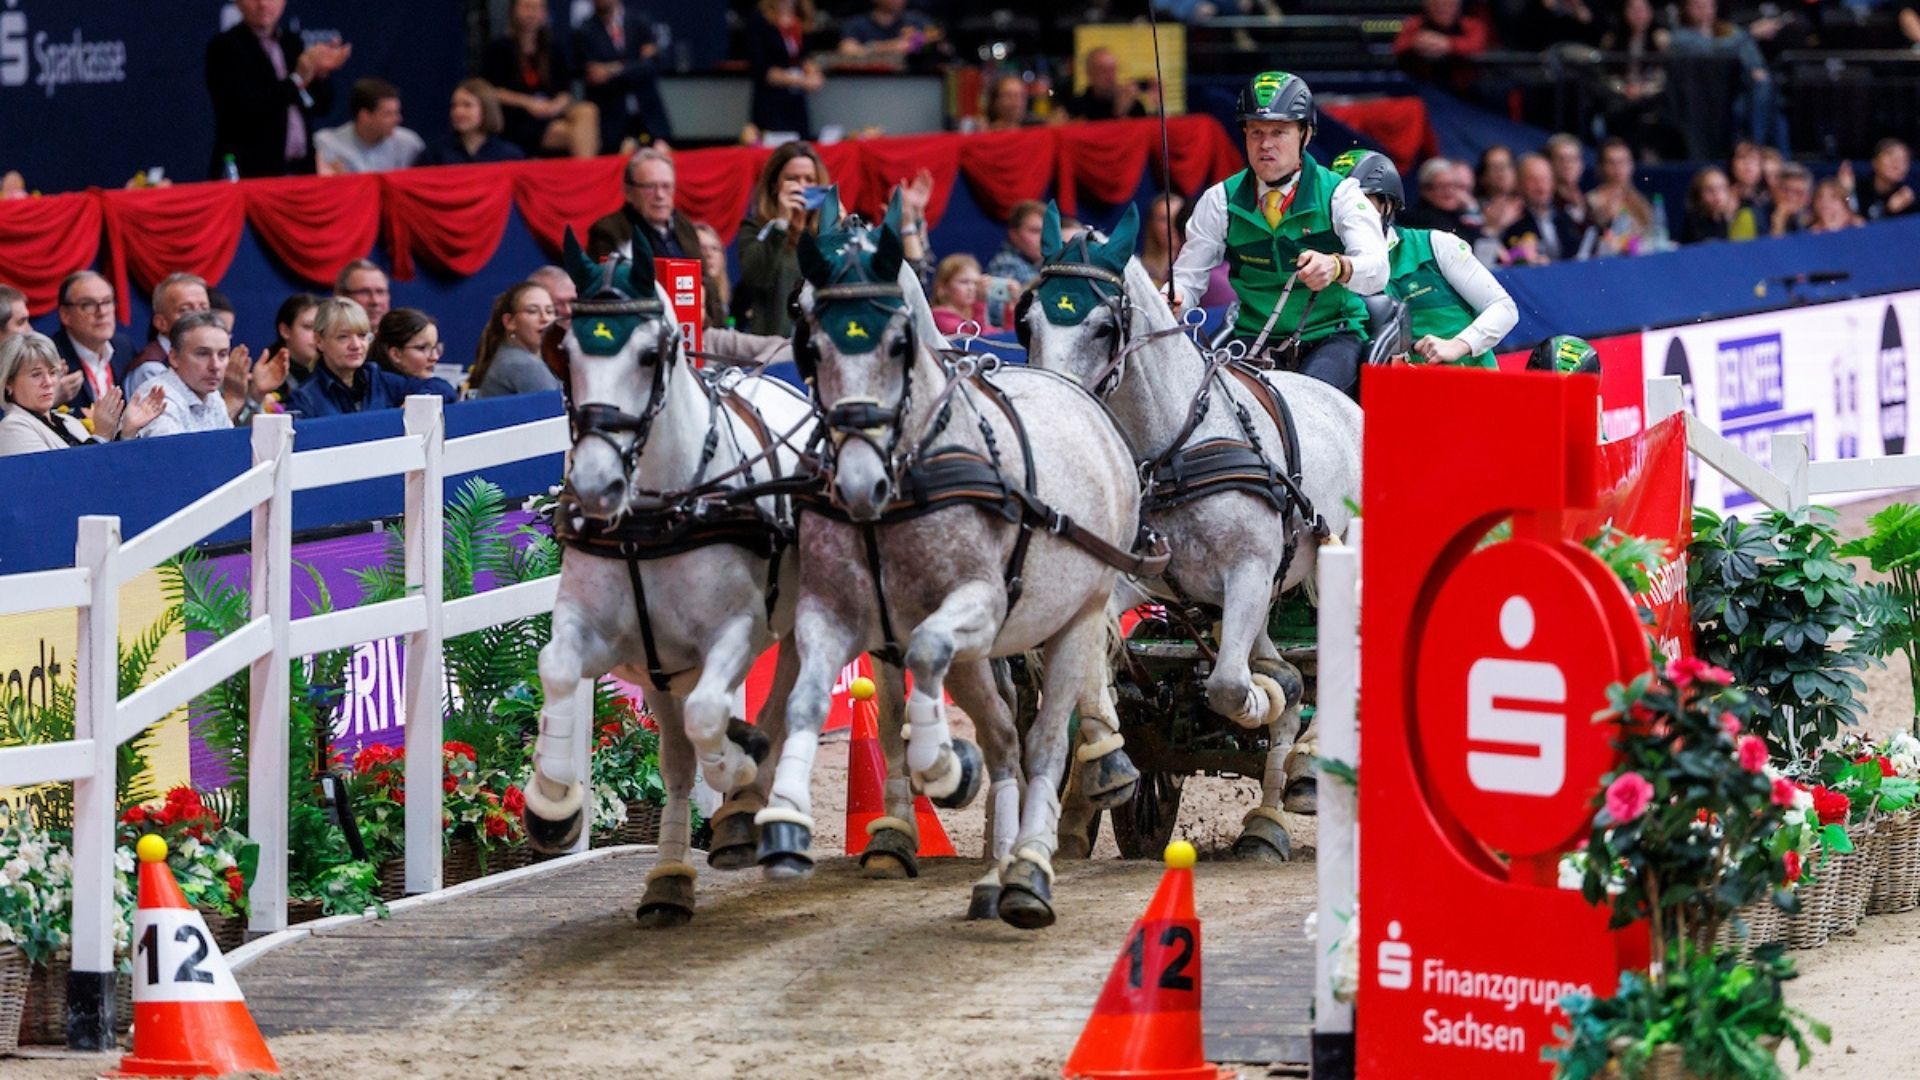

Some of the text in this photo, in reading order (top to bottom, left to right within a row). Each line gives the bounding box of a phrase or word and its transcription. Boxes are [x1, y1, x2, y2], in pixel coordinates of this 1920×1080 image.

[33, 27, 127, 97] Sparkasse
[138, 923, 215, 985] 12
[1124, 926, 1194, 992] 12
[1422, 1008, 1525, 1053] Sachsen
